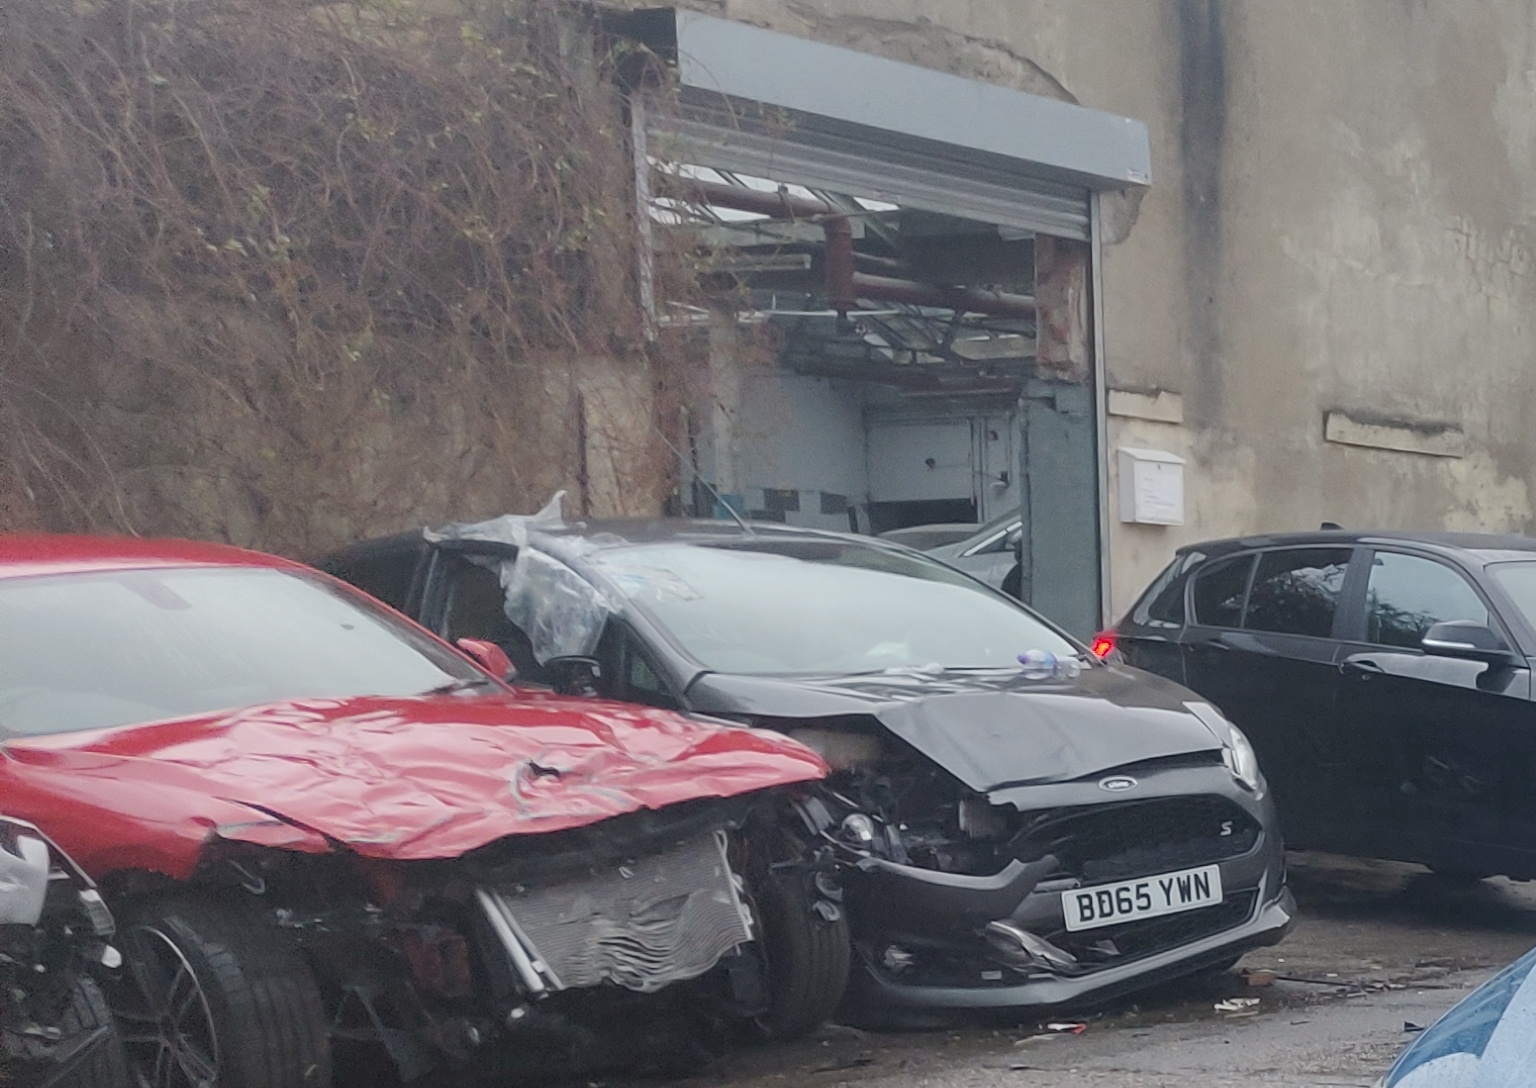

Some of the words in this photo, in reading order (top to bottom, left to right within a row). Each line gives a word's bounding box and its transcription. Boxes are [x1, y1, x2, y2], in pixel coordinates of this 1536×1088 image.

[1220, 820, 1233, 836] S
[1075, 882, 1152, 923] BD65
[1158, 871, 1211, 906] YWN
